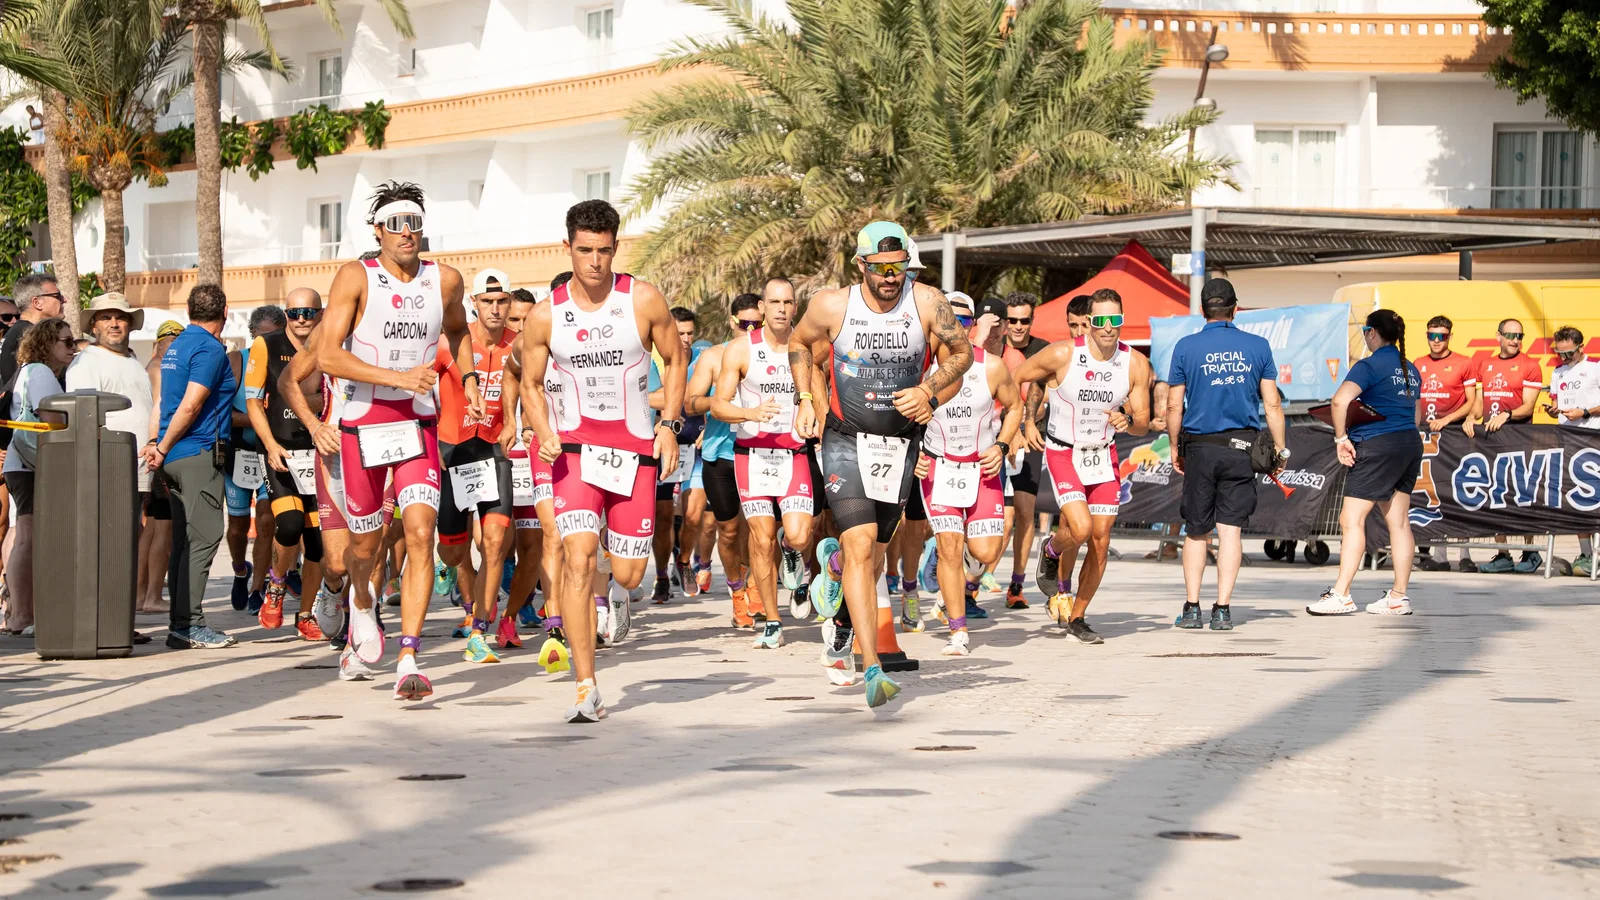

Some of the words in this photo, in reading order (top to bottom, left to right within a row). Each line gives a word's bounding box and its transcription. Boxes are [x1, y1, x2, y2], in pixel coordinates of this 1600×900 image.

[384, 321, 428, 339] CARDONA
[854, 331, 909, 350] ROVEDIELLO
[570, 350, 624, 368] FERNANDEZ
[870, 352, 919, 365] Puchet
[1205, 351, 1246, 363] OFICIAL
[887, 367, 897, 379] ES
[1200, 361, 1252, 376] TRIATLÓN
[1078, 389, 1114, 403] REDONDO
[946, 406, 972, 419] NACHO
[381, 447, 406, 461] 44
[597, 452, 623, 469] 40
[1083, 454, 1101, 467] 60
[244, 465, 258, 476] 81
[297, 468, 315, 479] 75
[762, 467, 779, 477] 42
[870, 462, 892, 478] 27
[465, 480, 485, 494] 26
[946, 477, 967, 490] 46
